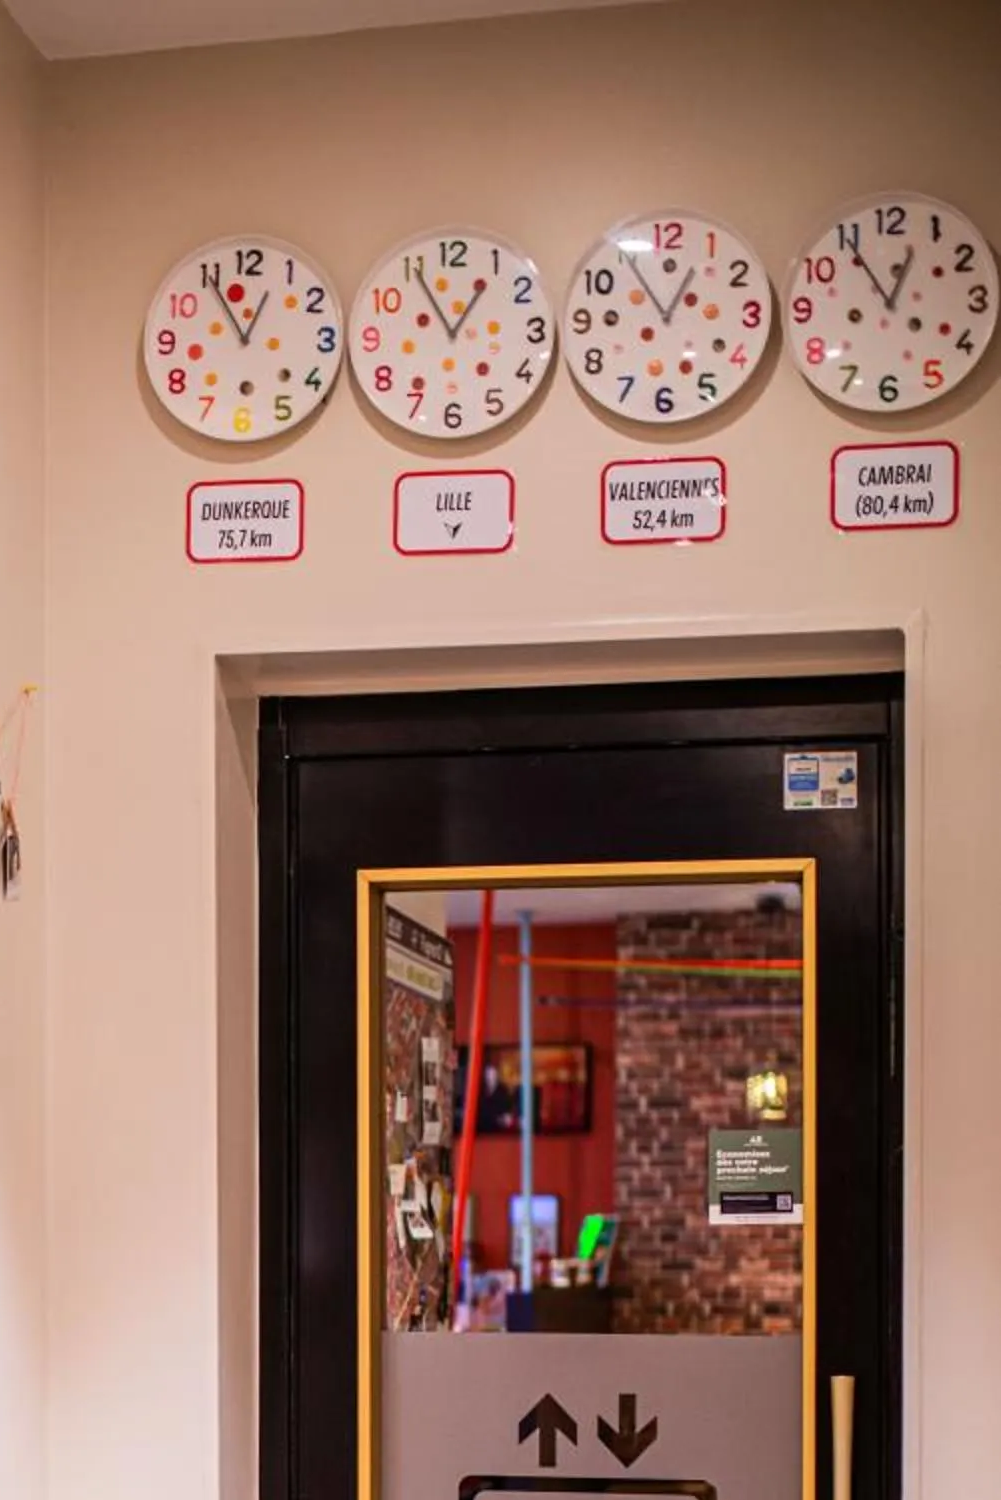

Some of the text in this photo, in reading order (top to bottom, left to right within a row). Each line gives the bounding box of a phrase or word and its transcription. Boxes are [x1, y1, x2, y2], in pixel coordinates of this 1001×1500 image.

[875, 207, 906, 235] 12
[931, 215, 942, 242] 1
[654, 223, 683, 249] 12
[706, 232, 716, 258] 1
[837, 224, 859, 250] 11
[236, 250, 263, 276] 12
[439, 241, 467, 267] 12
[491, 249, 500, 275] 1
[954, 244, 974, 272] 2
[201, 263, 220, 288] 11
[285, 260, 295, 284] 1
[404, 256, 425, 282] 11
[585, 269, 614, 295] 10
[729, 260, 749, 287] 2
[804, 257, 835, 284] 10
[306, 287, 325, 313] 2
[373, 287, 402, 314] 10
[514, 277, 533, 303] 2
[968, 285, 988, 313] 3
[170, 293, 198, 319] 10
[742, 301, 761, 327] 3
[793, 297, 812, 323] 9
[527, 317, 545, 343] 3
[572, 308, 591, 334] 9
[158, 330, 175, 355] 9
[317, 327, 336, 353] 3
[362, 326, 381, 352] 9
[807, 337, 825, 364] 8
[955, 329, 973, 355] 4
[585, 349, 603, 374] 8
[729, 343, 747, 368] 4
[168, 368, 186, 394] 8
[305, 368, 322, 391] 4
[374, 366, 392, 391] 8
[516, 358, 534, 384] 4
[839, 365, 858, 392] 7
[923, 360, 943, 388] 5
[617, 377, 635, 403] 7
[655, 387, 674, 413] 6
[698, 373, 717, 401] 5
[878, 376, 898, 402] 6
[198, 397, 215, 421] 7
[275, 396, 292, 420] 5
[406, 393, 424, 418] 7
[444, 403, 462, 428] 6
[485, 389, 504, 416] 5
[233, 408, 251, 433] 6
[858, 464, 932, 486] CAMBRAI
[435, 491, 473, 513] LILLE
[855, 490, 934, 518] (80,4 km)
[632, 508, 694, 532] 52,4 km
[218, 529, 272, 551] 75,7 km
